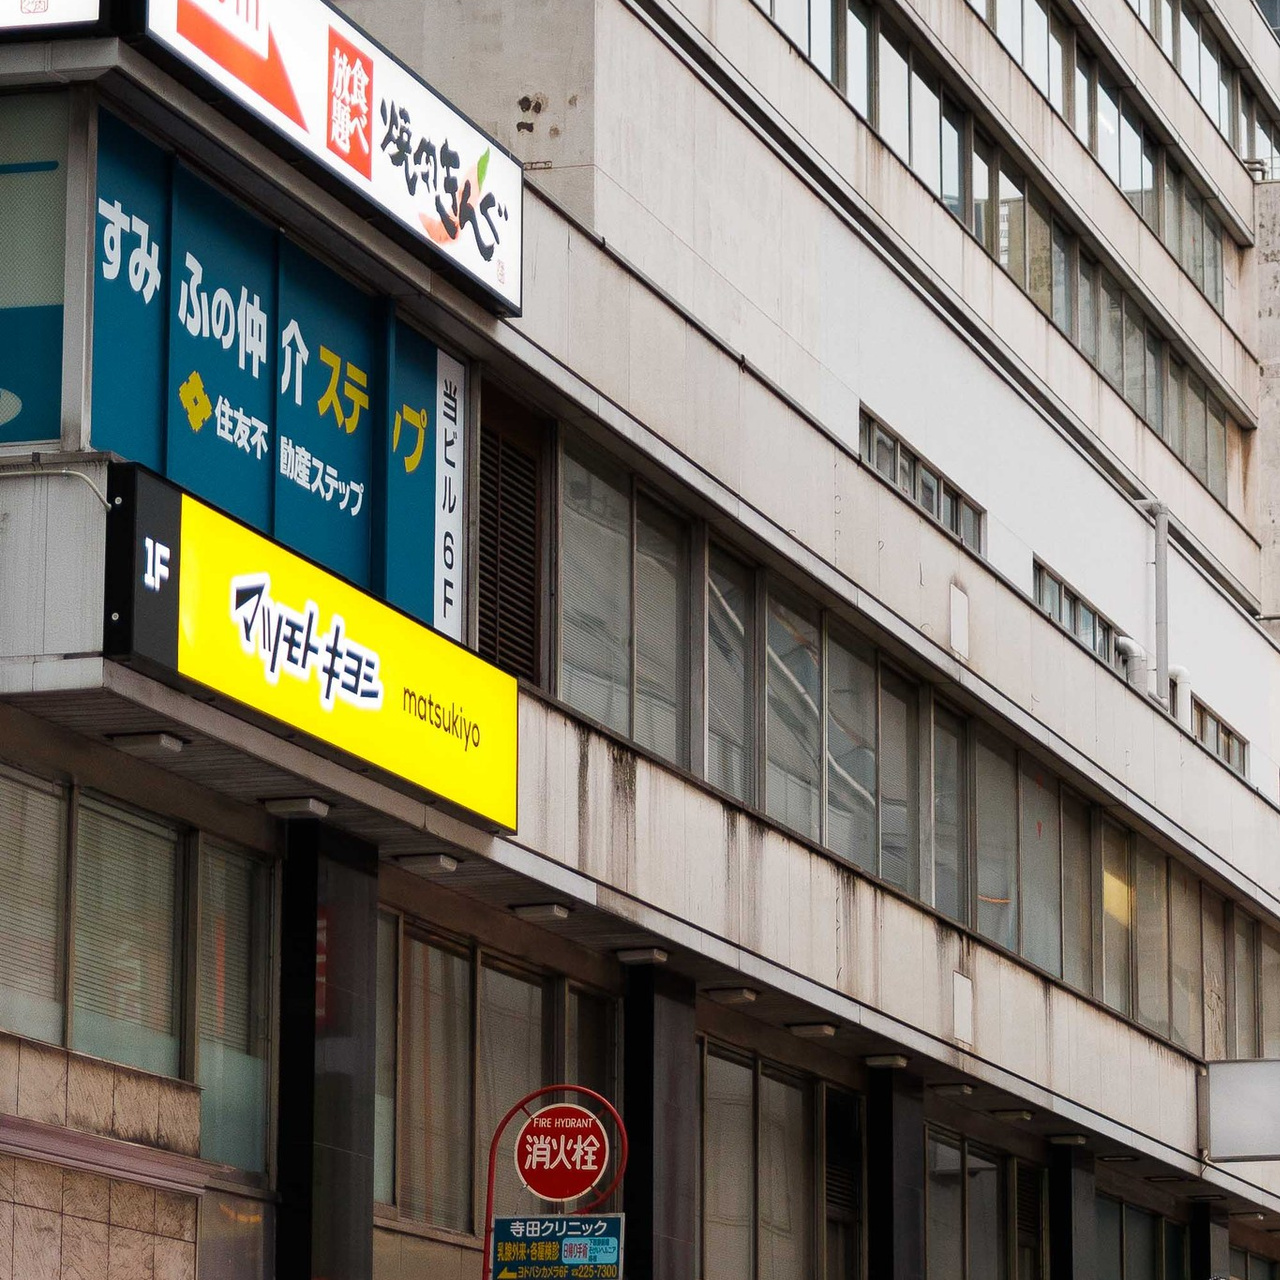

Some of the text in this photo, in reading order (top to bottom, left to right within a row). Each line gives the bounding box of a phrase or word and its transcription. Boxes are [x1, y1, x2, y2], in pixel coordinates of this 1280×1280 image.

[380, 97, 508, 262] 焼肉きんぐ
[214, 394, 364, 517] 住友不動産ステップ
[143, 536, 170, 592] 1F
[233, 578, 382, 703] マツモトキヨシ
[403, 682, 482, 753] matsukiyo
[533, 1118, 593, 1128] FIRE HYDRANT
[524, 1134, 600, 1170] 消火栓
[510, 1221, 607, 1237] 寺田クリニック
[579, 1265, 617, 1278] 225-7300
